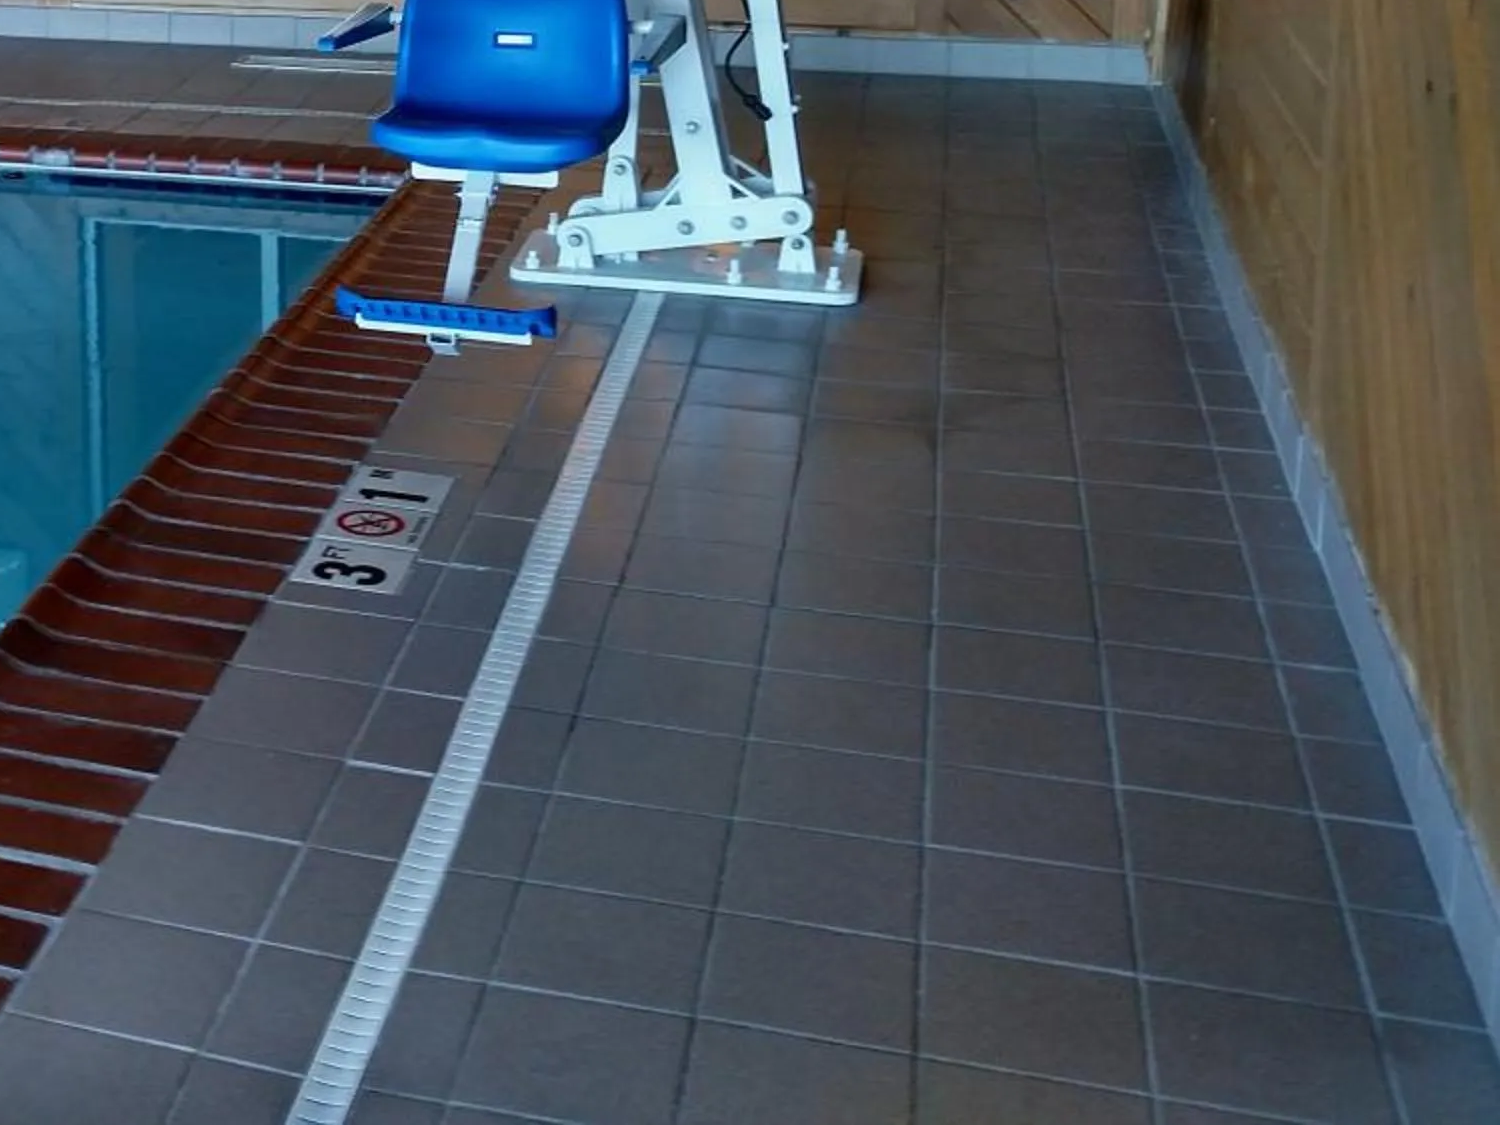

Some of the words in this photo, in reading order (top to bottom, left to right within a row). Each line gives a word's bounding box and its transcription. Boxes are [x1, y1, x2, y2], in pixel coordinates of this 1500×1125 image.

[359, 488, 428, 503] 1
[322, 546, 350, 559] FT
[312, 561, 387, 585] 3
